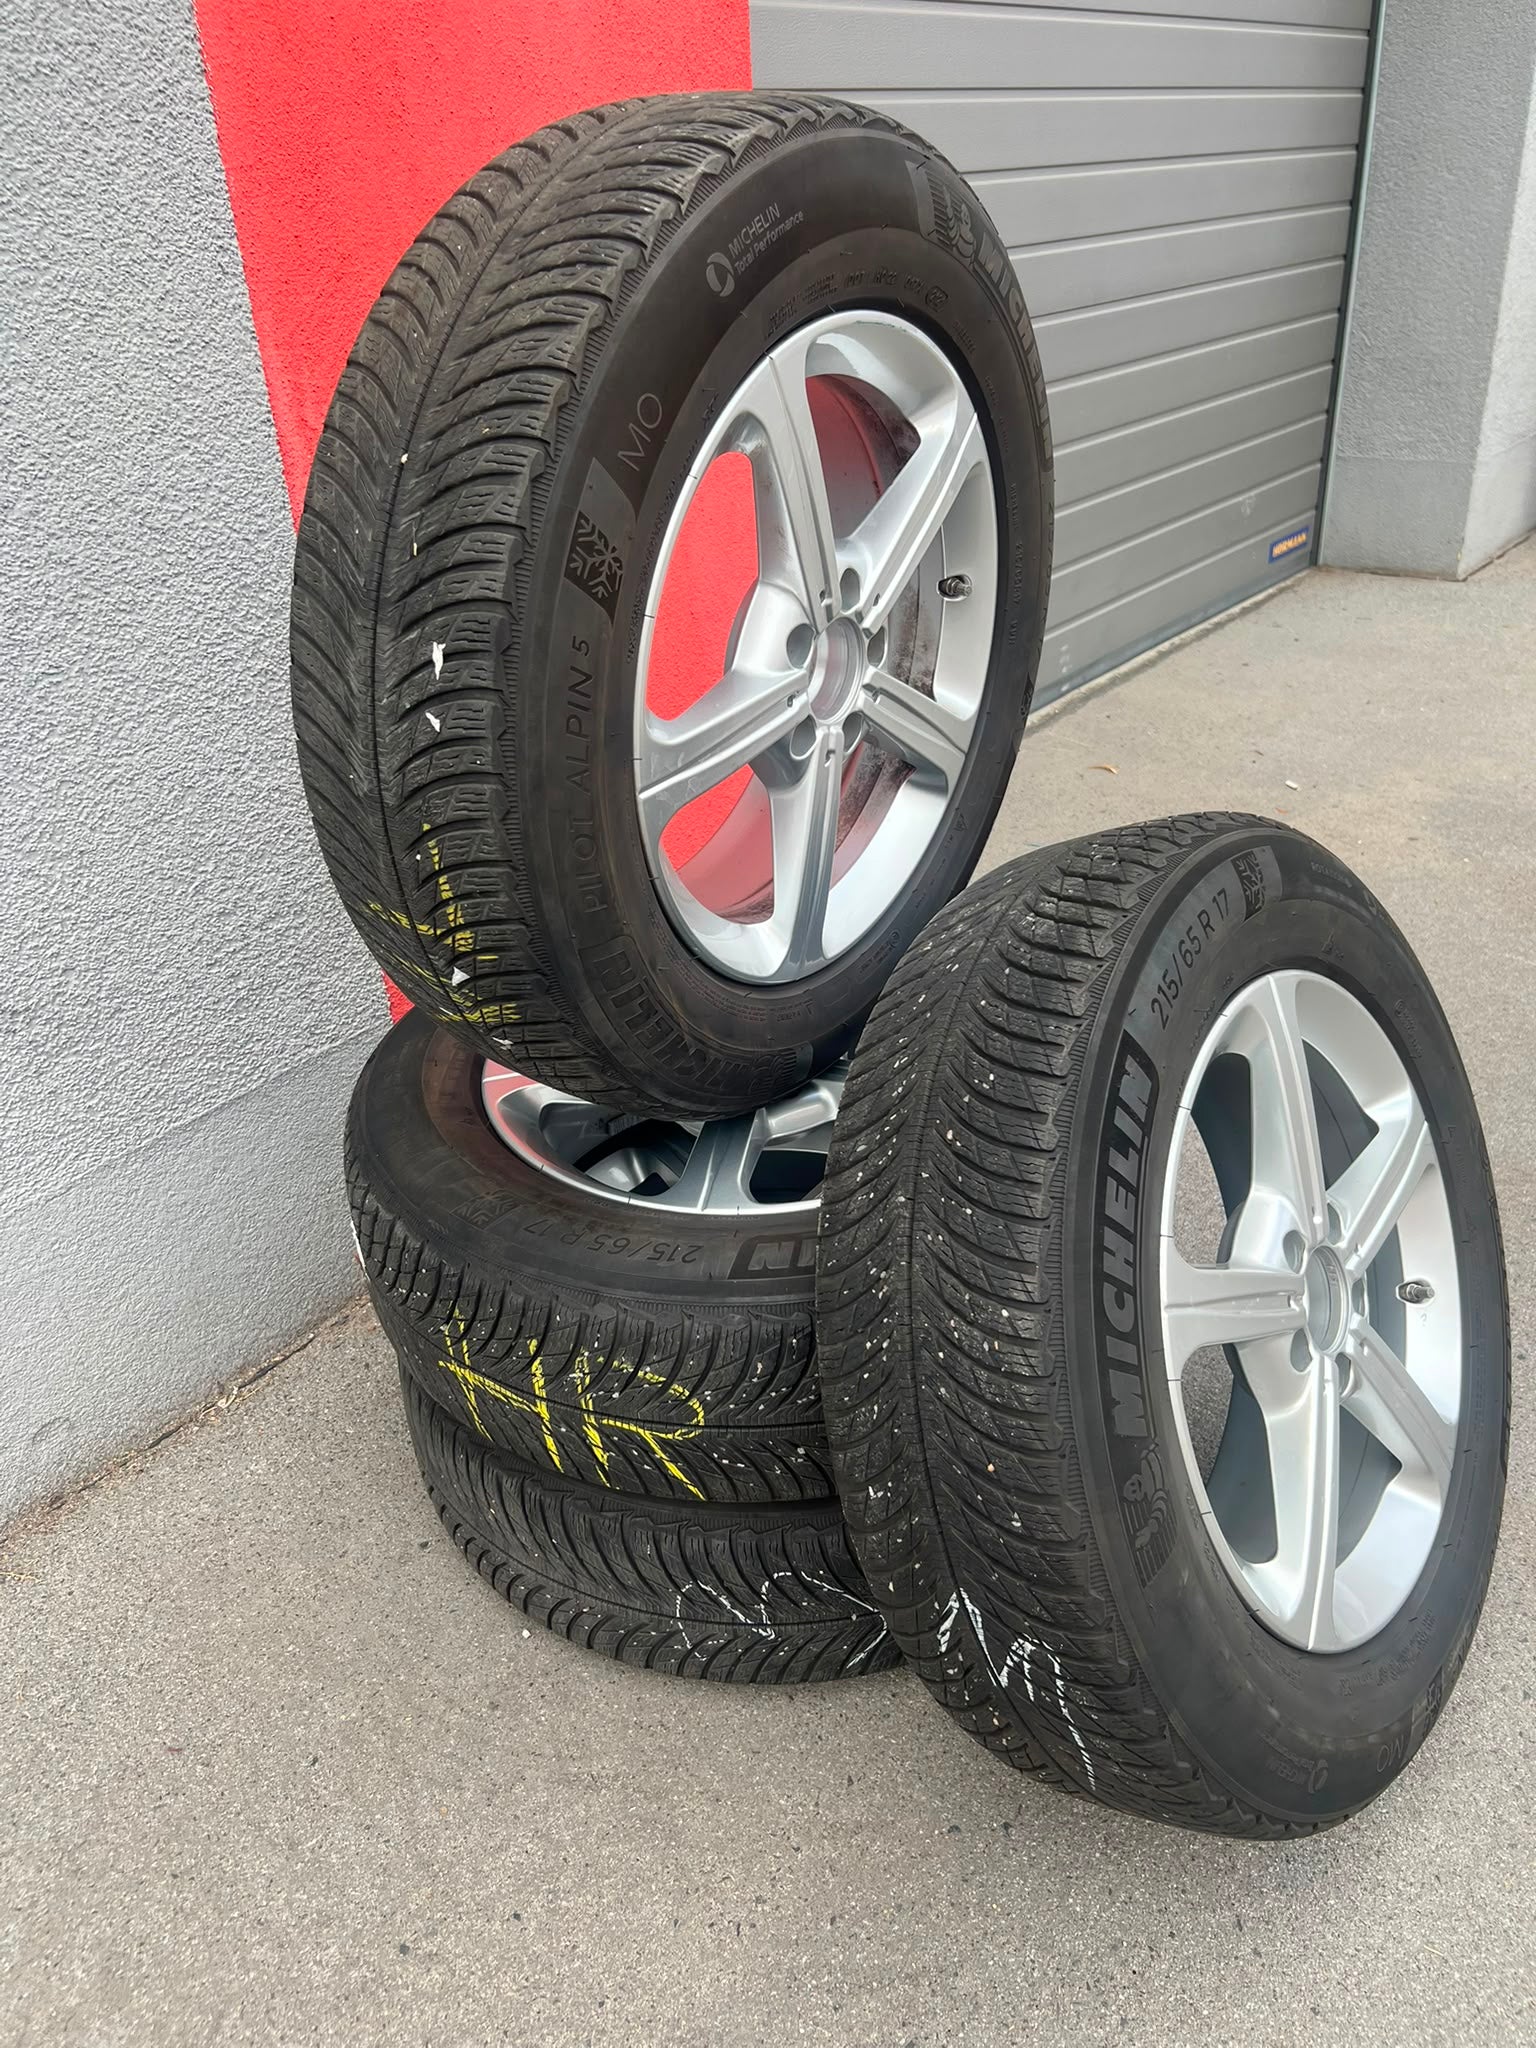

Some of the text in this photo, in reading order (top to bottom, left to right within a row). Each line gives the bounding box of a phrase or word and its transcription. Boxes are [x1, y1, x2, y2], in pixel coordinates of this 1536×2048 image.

[728, 202, 780, 258] MICHELIN
[734, 211, 804, 275] Total Performance
[976, 231, 1051, 459] MICHELIN
[617, 392, 663, 473] MO
[565, 635, 609, 913] PILOT ALPIN 5
[1151, 887, 1231, 1030] 215/65 R 17
[523, 1218, 704, 1264] 215/65 R 17
[1103, 1054, 1153, 1438] MICHELIN
